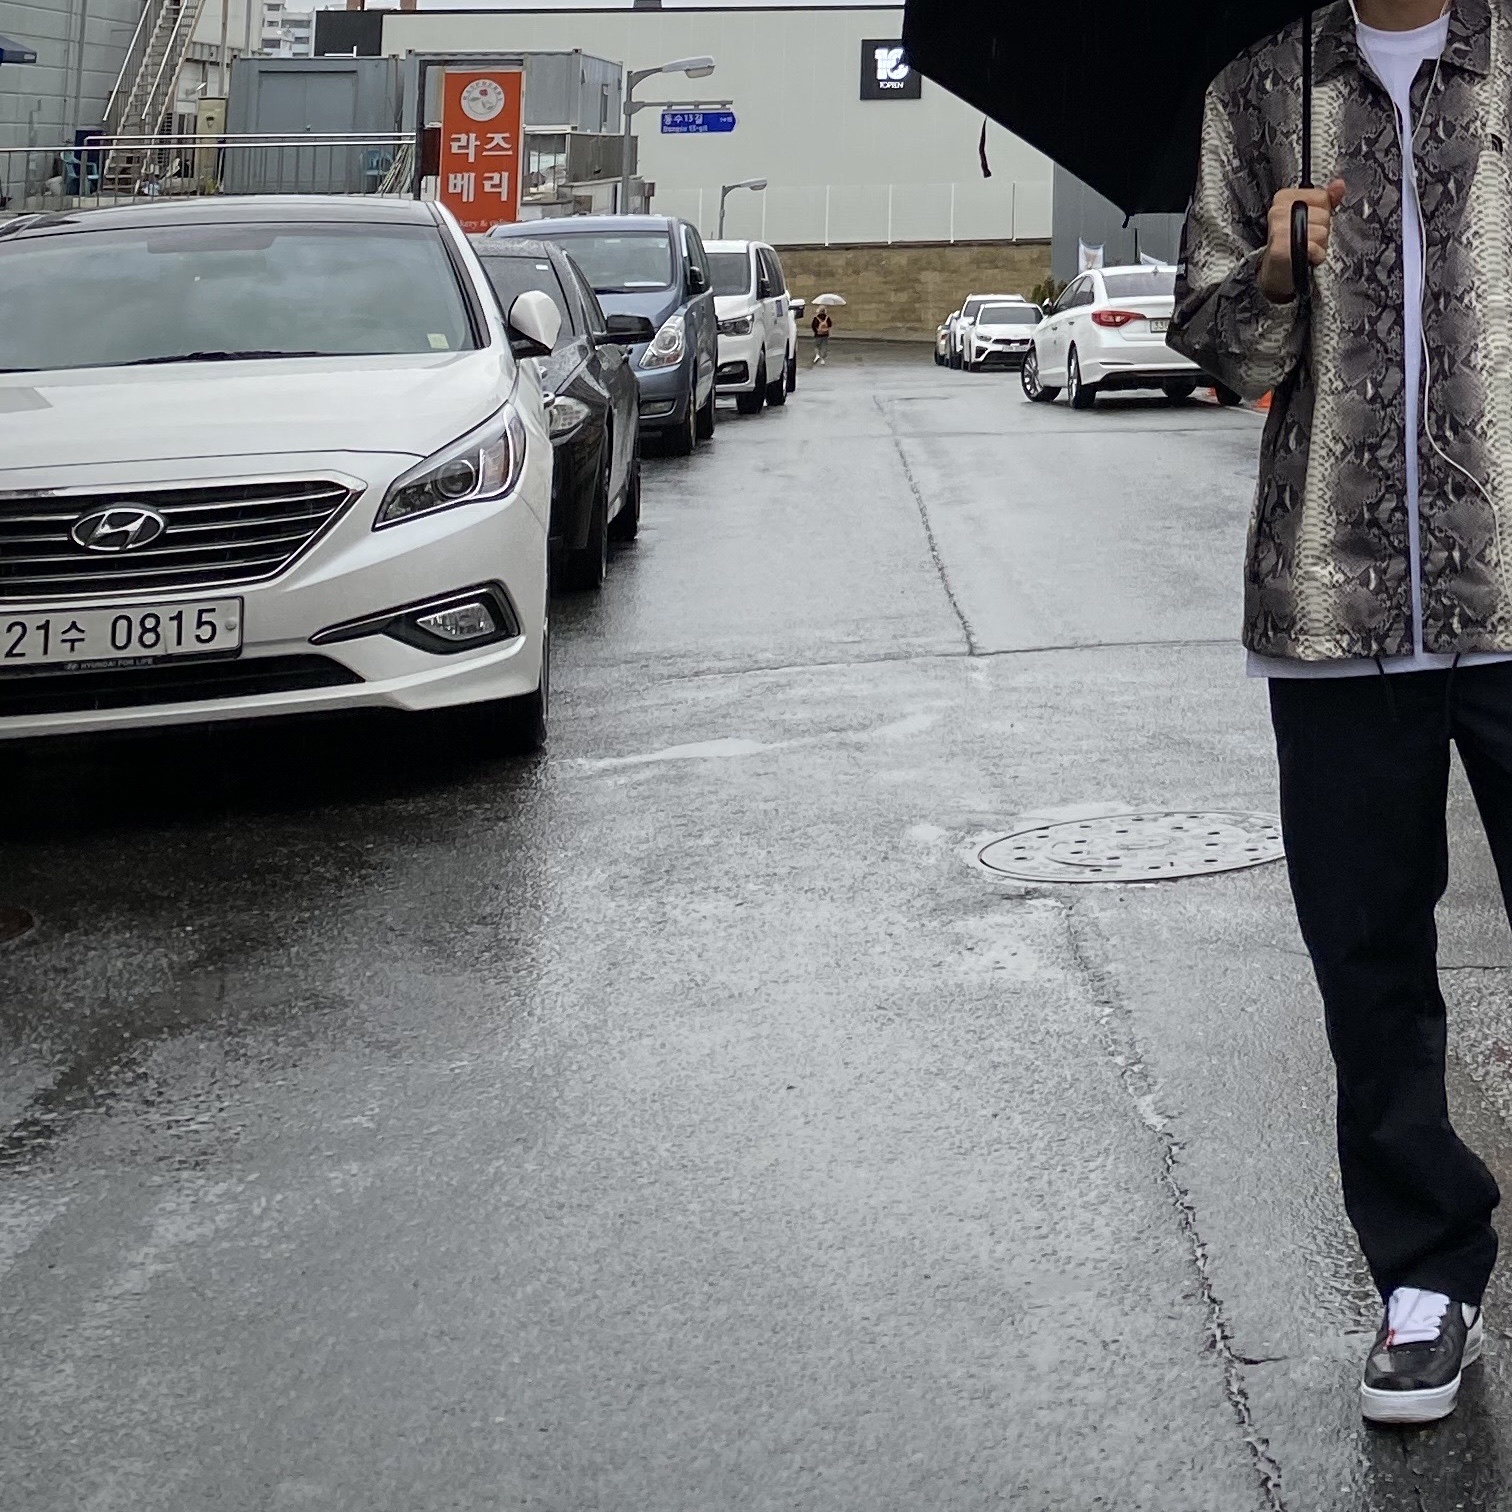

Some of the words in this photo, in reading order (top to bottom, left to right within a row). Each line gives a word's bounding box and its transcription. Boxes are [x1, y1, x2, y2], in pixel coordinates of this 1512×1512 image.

[450, 133, 512, 163] 라즈
[448, 172, 509, 203] 베리
[4, 619, 86, 659] 21수
[110, 608, 217, 651] 0815
